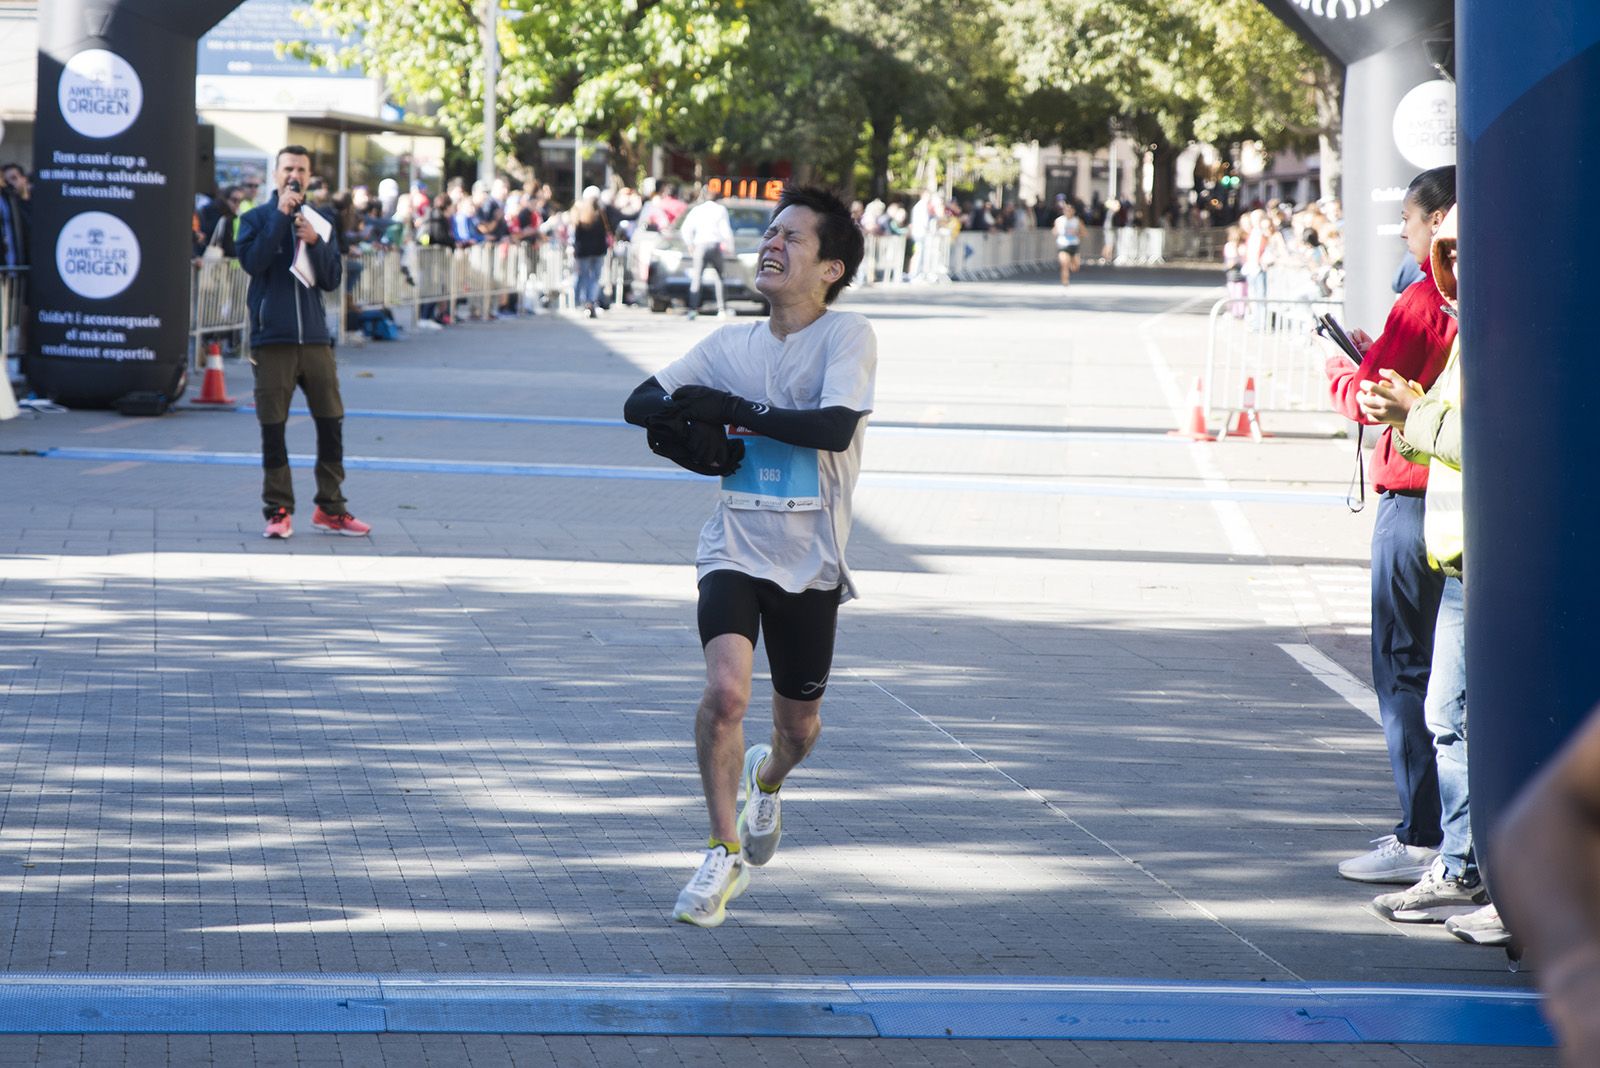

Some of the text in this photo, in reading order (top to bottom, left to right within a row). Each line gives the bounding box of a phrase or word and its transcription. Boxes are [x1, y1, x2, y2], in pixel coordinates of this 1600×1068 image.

[69, 86, 129, 100] AMETLLER
[67, 98, 129, 115] ORIGEN
[112, 155, 136, 169] cap
[137, 156, 148, 167] a
[78, 168, 104, 181] més
[106, 170, 167, 185] saludable
[68, 184, 135, 199] sostenible
[66, 247, 128, 260] AMETLLER
[65, 259, 127, 276] ORIGEN
[83, 313, 161, 330] aconsegueix
[65, 327, 78, 341] el
[102, 346, 157, 361] esportiu
[760, 468, 781, 482] 1363
